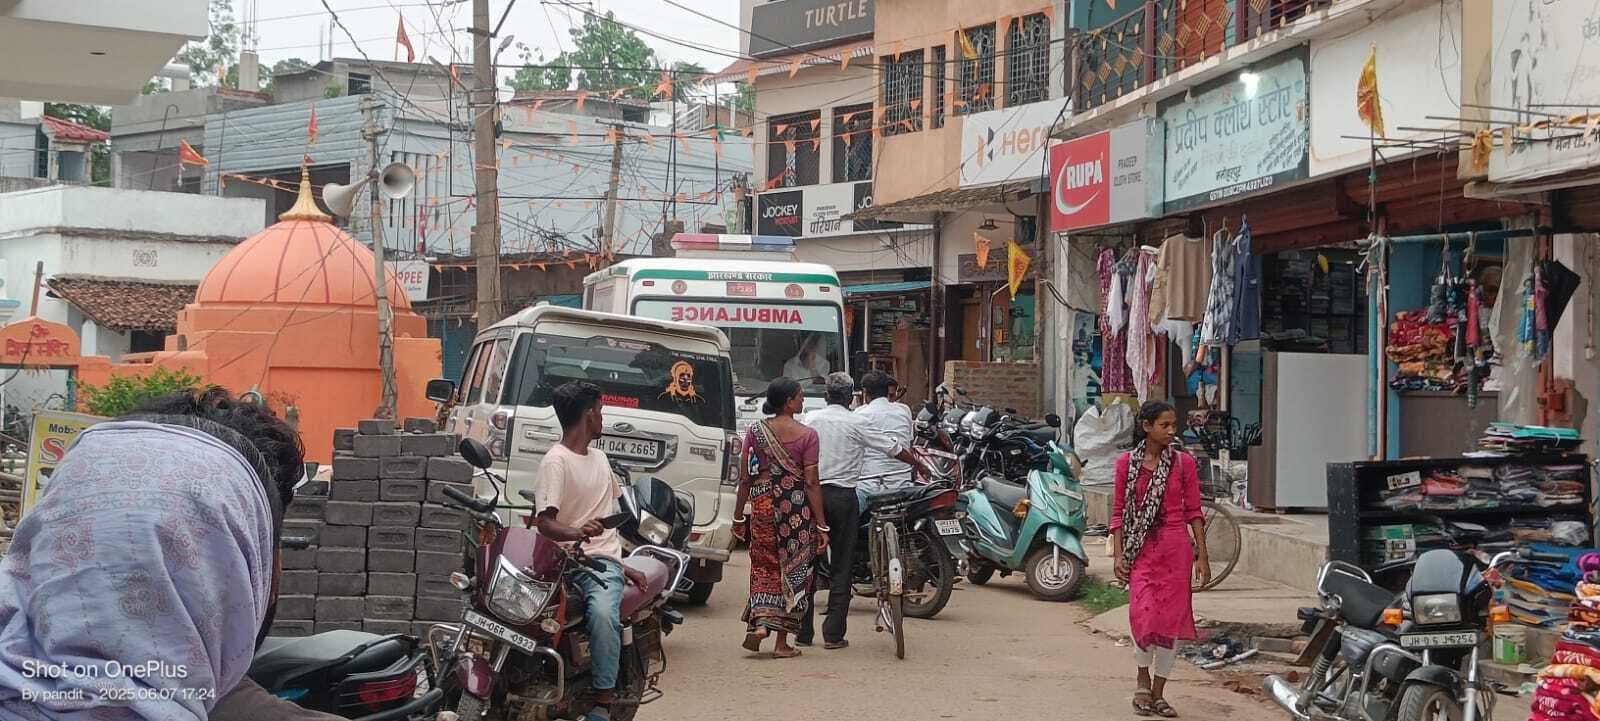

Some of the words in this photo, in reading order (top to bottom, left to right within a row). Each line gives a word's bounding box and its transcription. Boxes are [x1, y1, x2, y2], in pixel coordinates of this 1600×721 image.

[805, 0, 868, 29] TURTLE
[1174, 108, 1208, 154] प्रदीप
[1258, 80, 1292, 127] स्टोर
[1066, 158, 1103, 190] RUPA
[762, 204, 798, 219] JOCKEY
[609, 440, 626, 453] 04K
[630, 442, 656, 456] 2665
